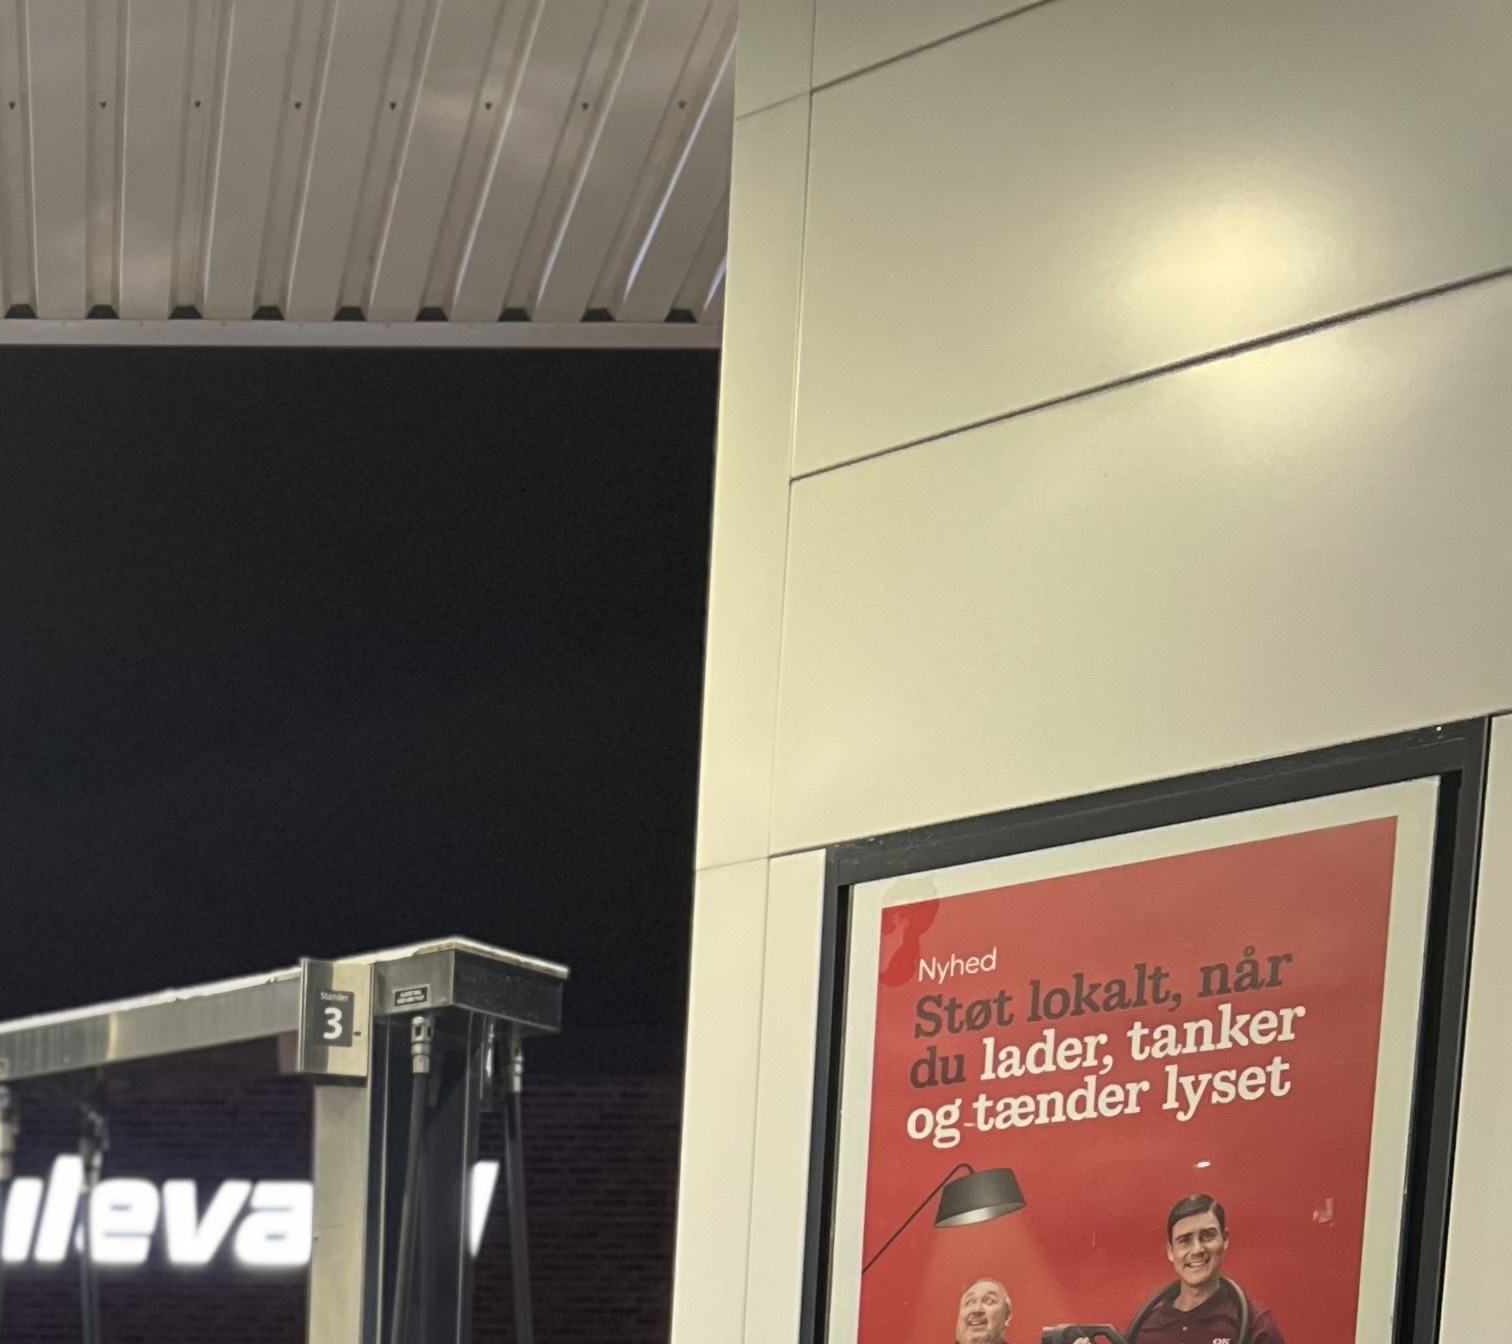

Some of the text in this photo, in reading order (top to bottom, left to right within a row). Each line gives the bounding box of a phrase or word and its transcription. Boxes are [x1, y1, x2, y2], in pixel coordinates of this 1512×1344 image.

[914, 945, 1293, 1039] Støt lokalt, når
[918, 947, 997, 984] Nyhed
[323, 1007, 343, 1039] 3
[910, 1002, 1306, 1089] du lader, tanker
[906, 1056, 1291, 1149] og tænder lyset
